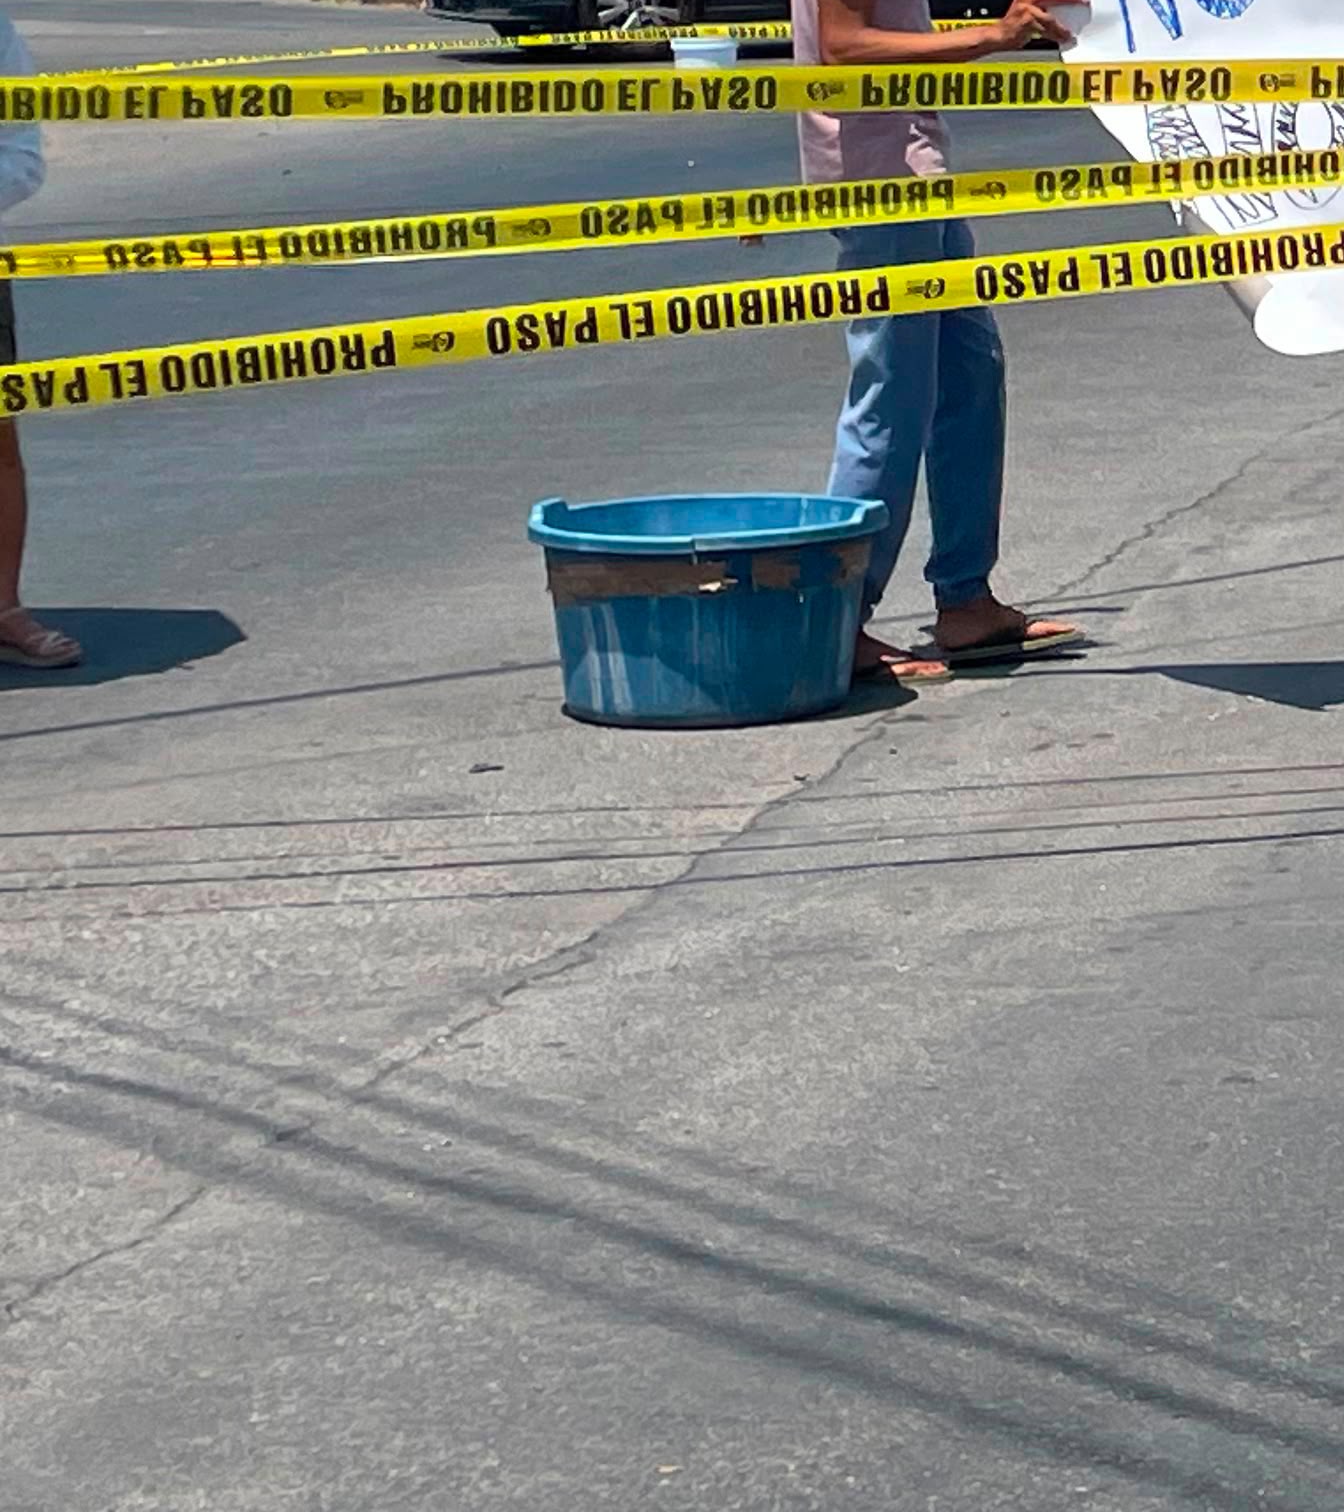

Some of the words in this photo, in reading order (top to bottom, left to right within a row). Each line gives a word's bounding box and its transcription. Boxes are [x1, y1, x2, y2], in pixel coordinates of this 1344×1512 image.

[975, 254, 1081, 302] PASO
[1089, 251, 1132, 290] EL
[609, 299, 655, 340] EL
[667, 276, 890, 335] PROHIBIDO
[486, 304, 599, 357] PASO
[98, 363, 149, 399] EL
[160, 329, 397, 392] PROHIBIDO
